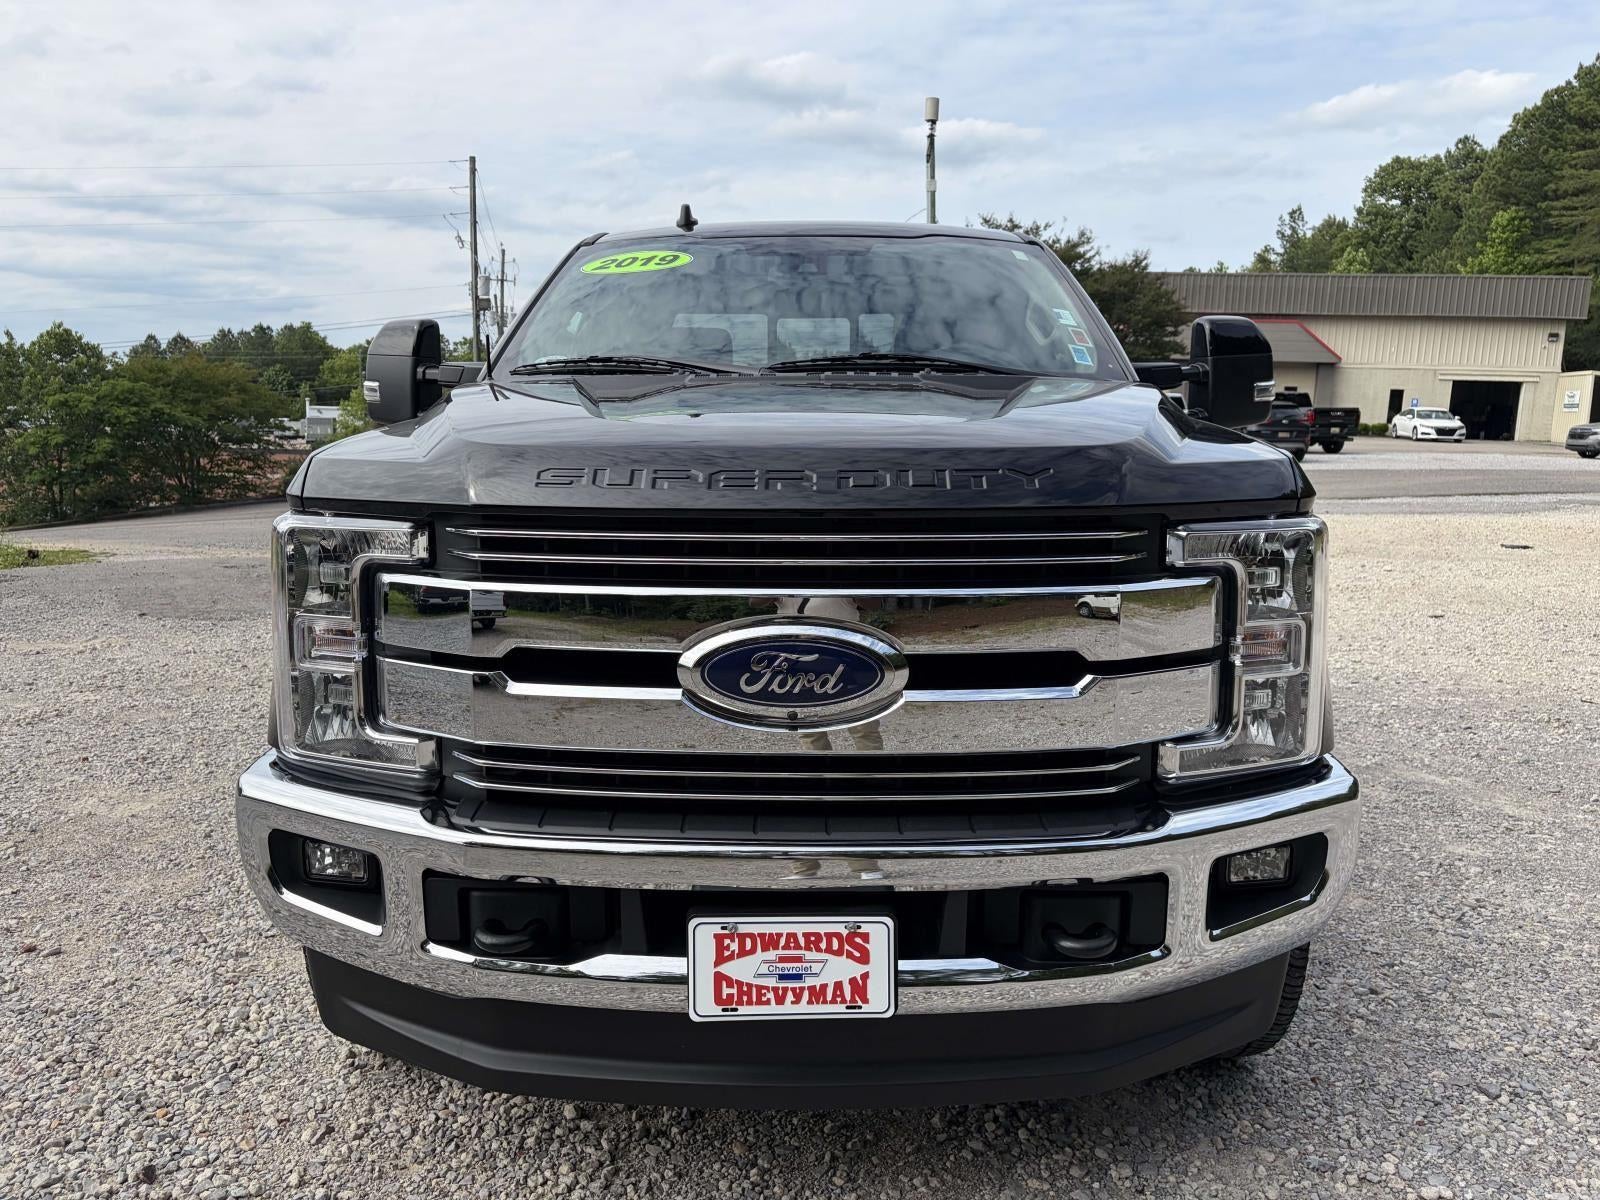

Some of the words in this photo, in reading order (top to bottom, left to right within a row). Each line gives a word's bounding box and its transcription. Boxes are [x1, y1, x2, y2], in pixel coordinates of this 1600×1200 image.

[590, 254, 681, 271] 2019
[534, 466, 818, 491] SUPER
[836, 467, 1054, 490] DUTY
[739, 650, 846, 694] Ford
[713, 931, 871, 969] EDWARDS
[767, 963, 813, 974] Chevrolet
[713, 970, 870, 1007] CHEVYMAN
